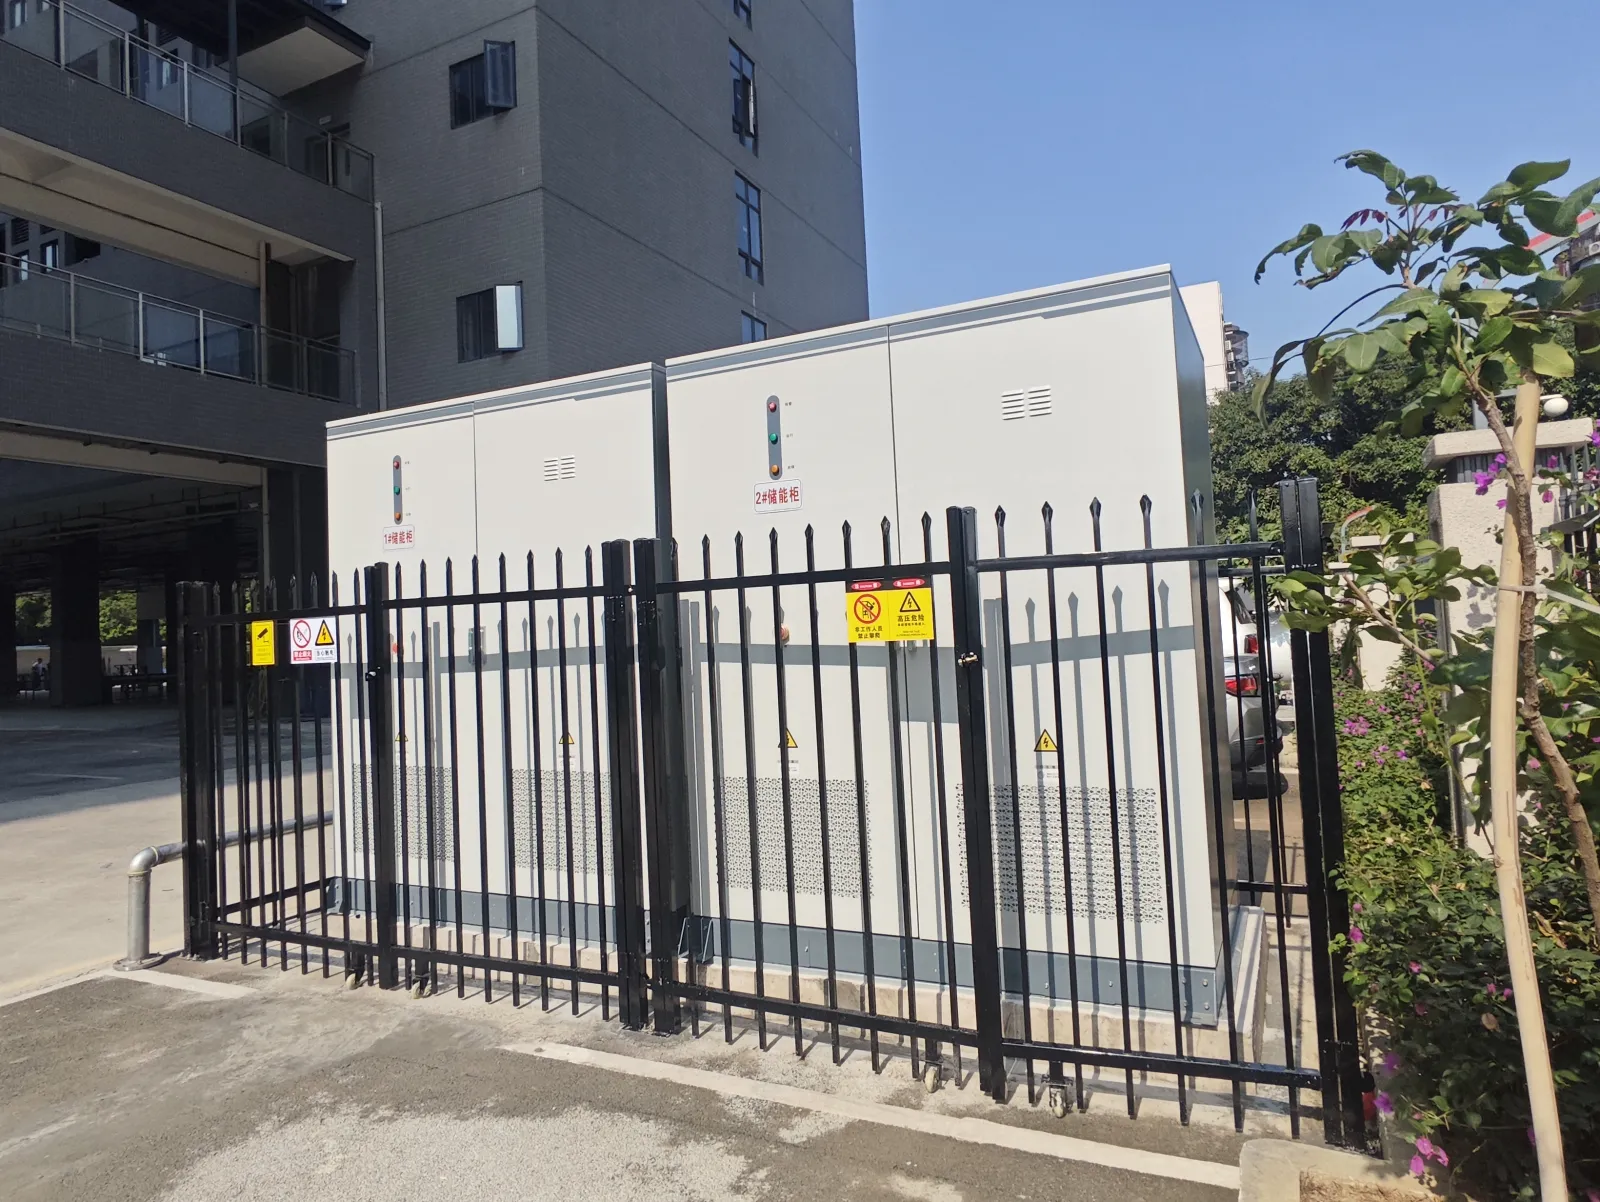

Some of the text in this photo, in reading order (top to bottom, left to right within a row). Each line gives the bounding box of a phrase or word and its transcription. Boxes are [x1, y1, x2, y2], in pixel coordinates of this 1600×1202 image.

[755, 486, 800, 505] 2#储能柜
[384, 530, 413, 545] 1#储能柜
[897, 614, 925, 622] 高压危险
